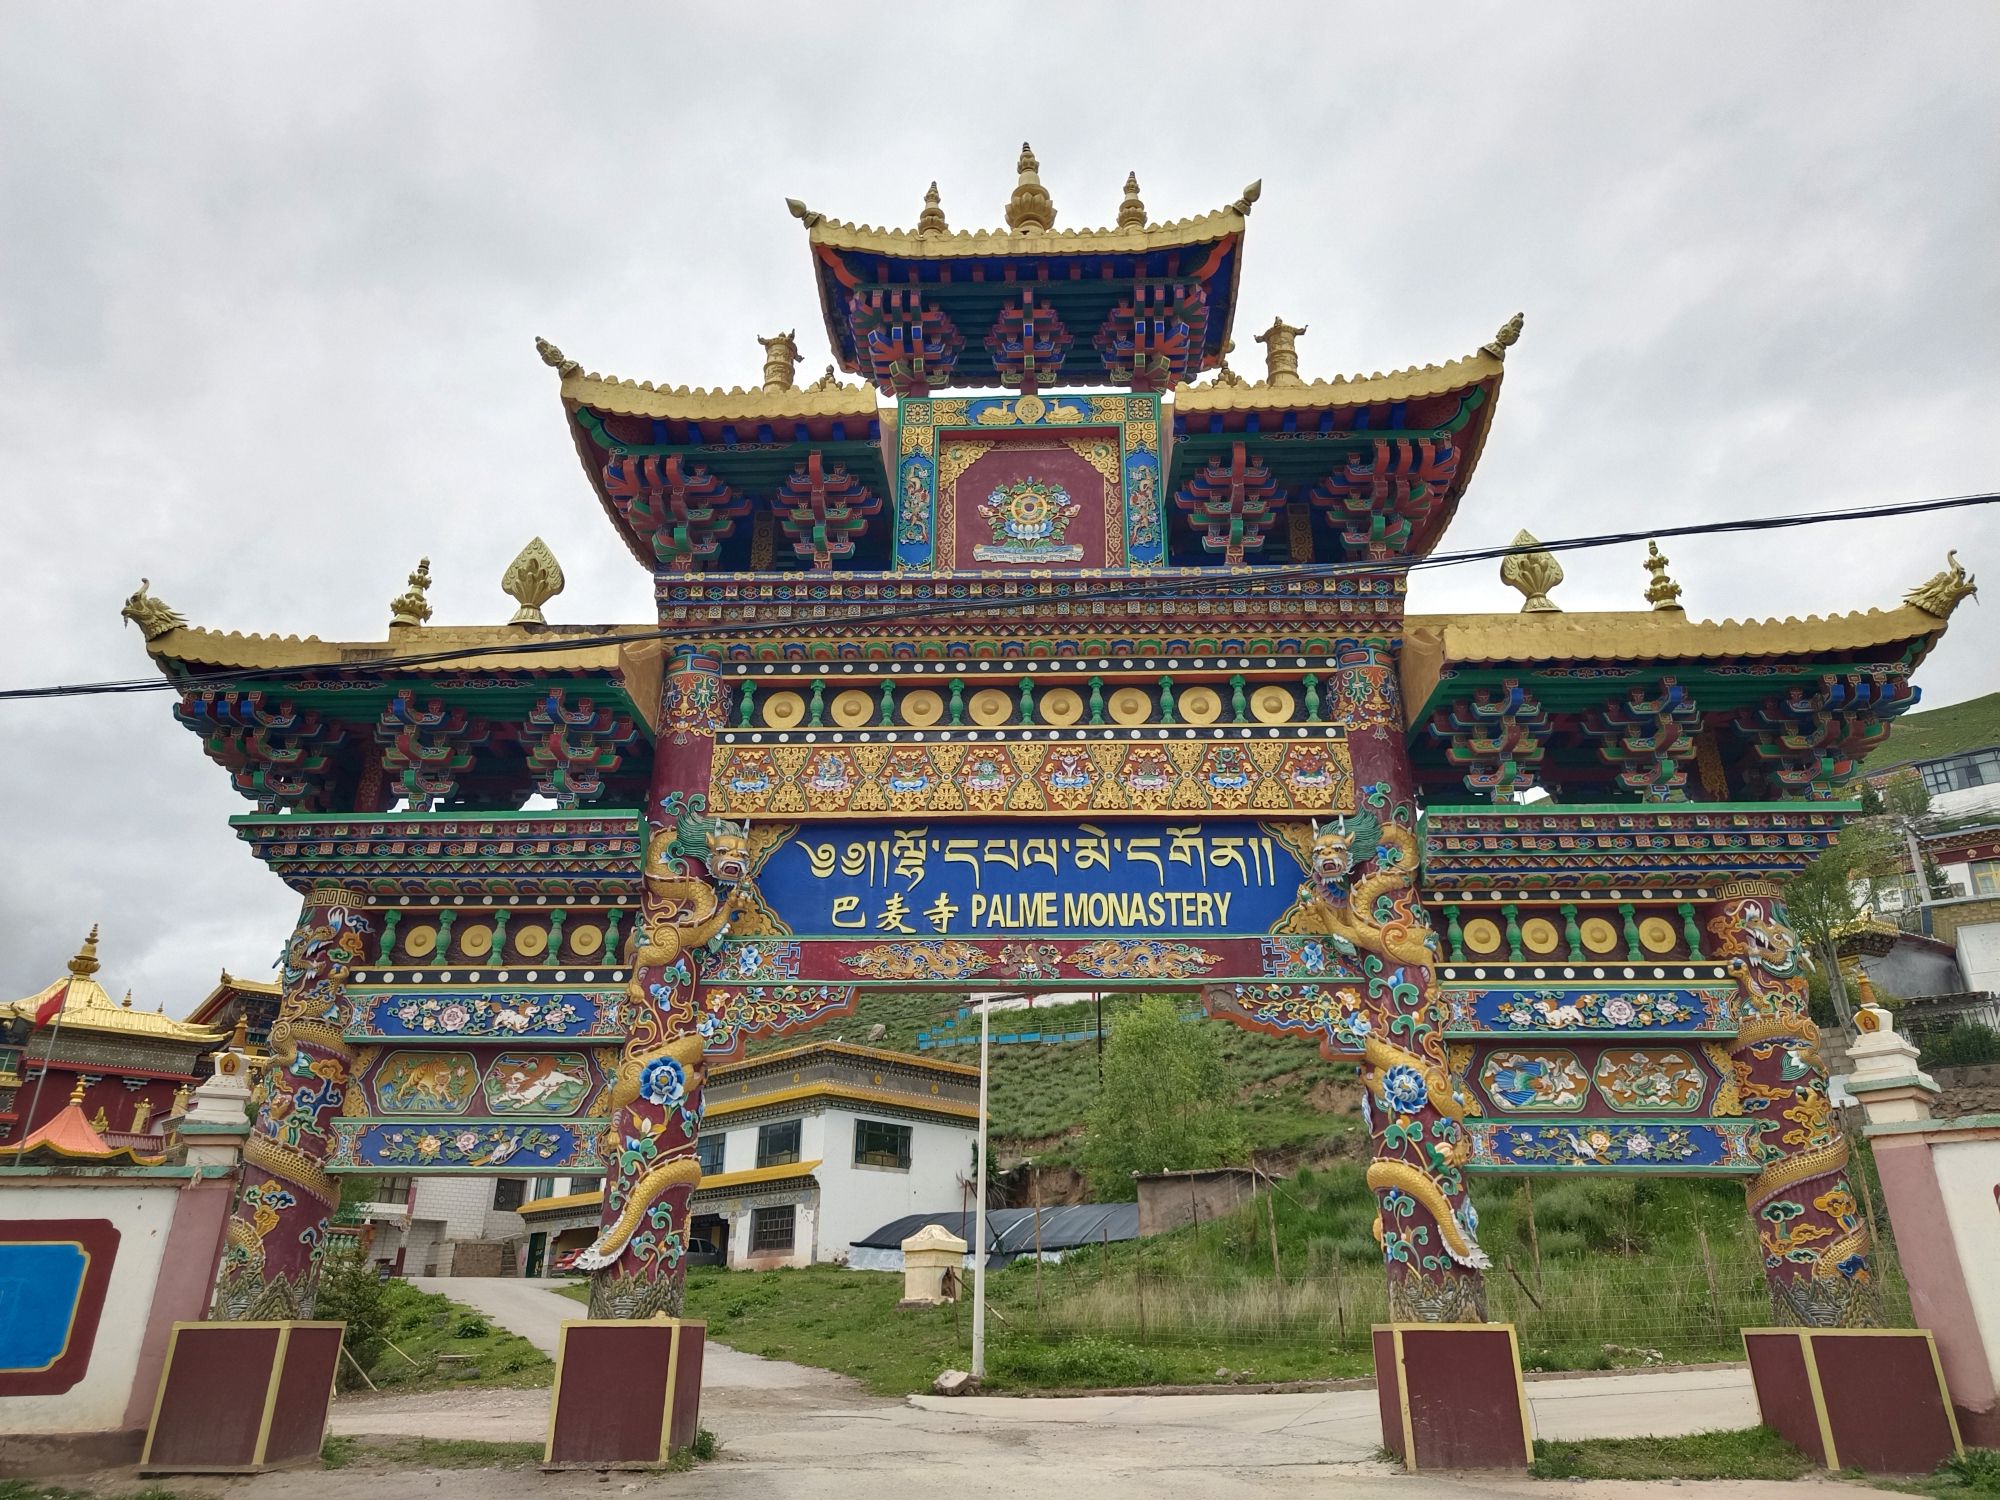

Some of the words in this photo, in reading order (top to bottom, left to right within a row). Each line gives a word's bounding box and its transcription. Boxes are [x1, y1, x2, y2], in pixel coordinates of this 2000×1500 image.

[831, 892, 959, 934] 巴麦寺
[971, 892, 1058, 928] PALME
[1064, 891, 1232, 927] MONASTERY
